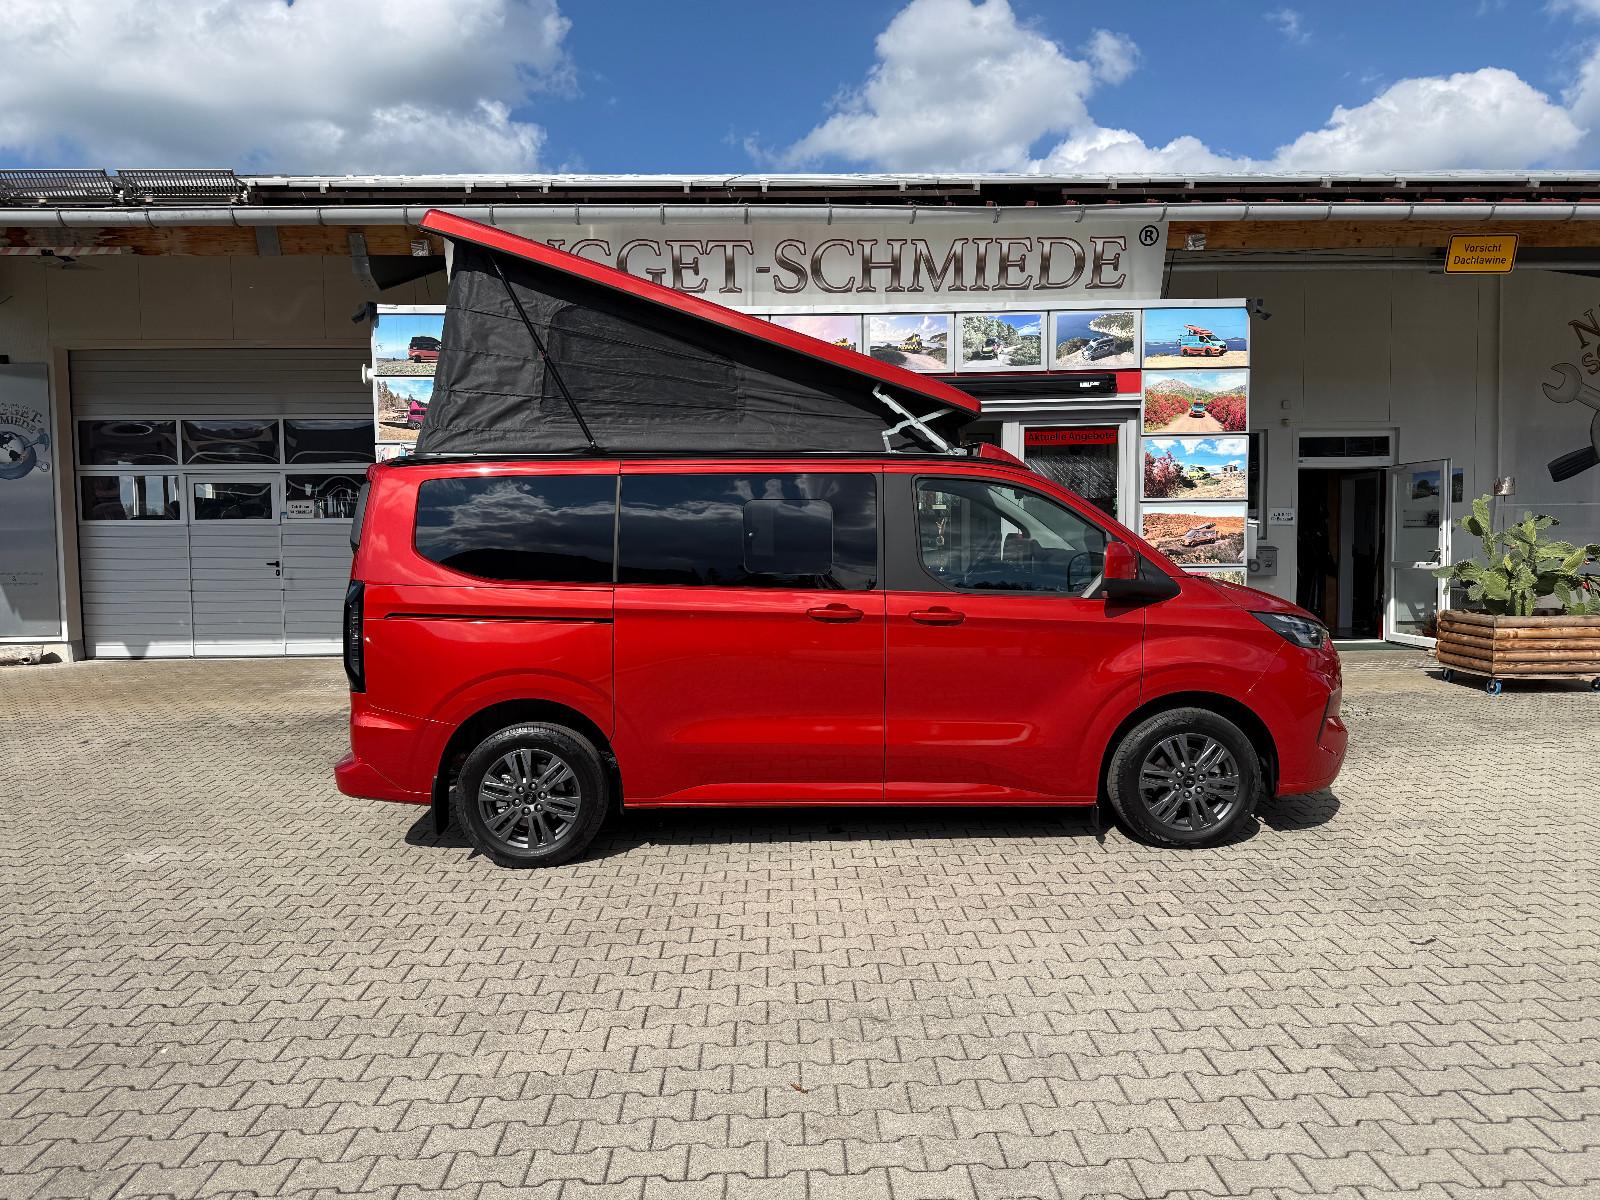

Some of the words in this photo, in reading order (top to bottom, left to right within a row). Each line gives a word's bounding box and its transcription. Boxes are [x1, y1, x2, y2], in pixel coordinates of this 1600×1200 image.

[1464, 243, 1502, 253] Vorsicht
[1453, 255, 1507, 265] Dachlawine
[1028, 431, 1067, 442] Aktuelle
[1069, 430, 1115, 442] Angebote
